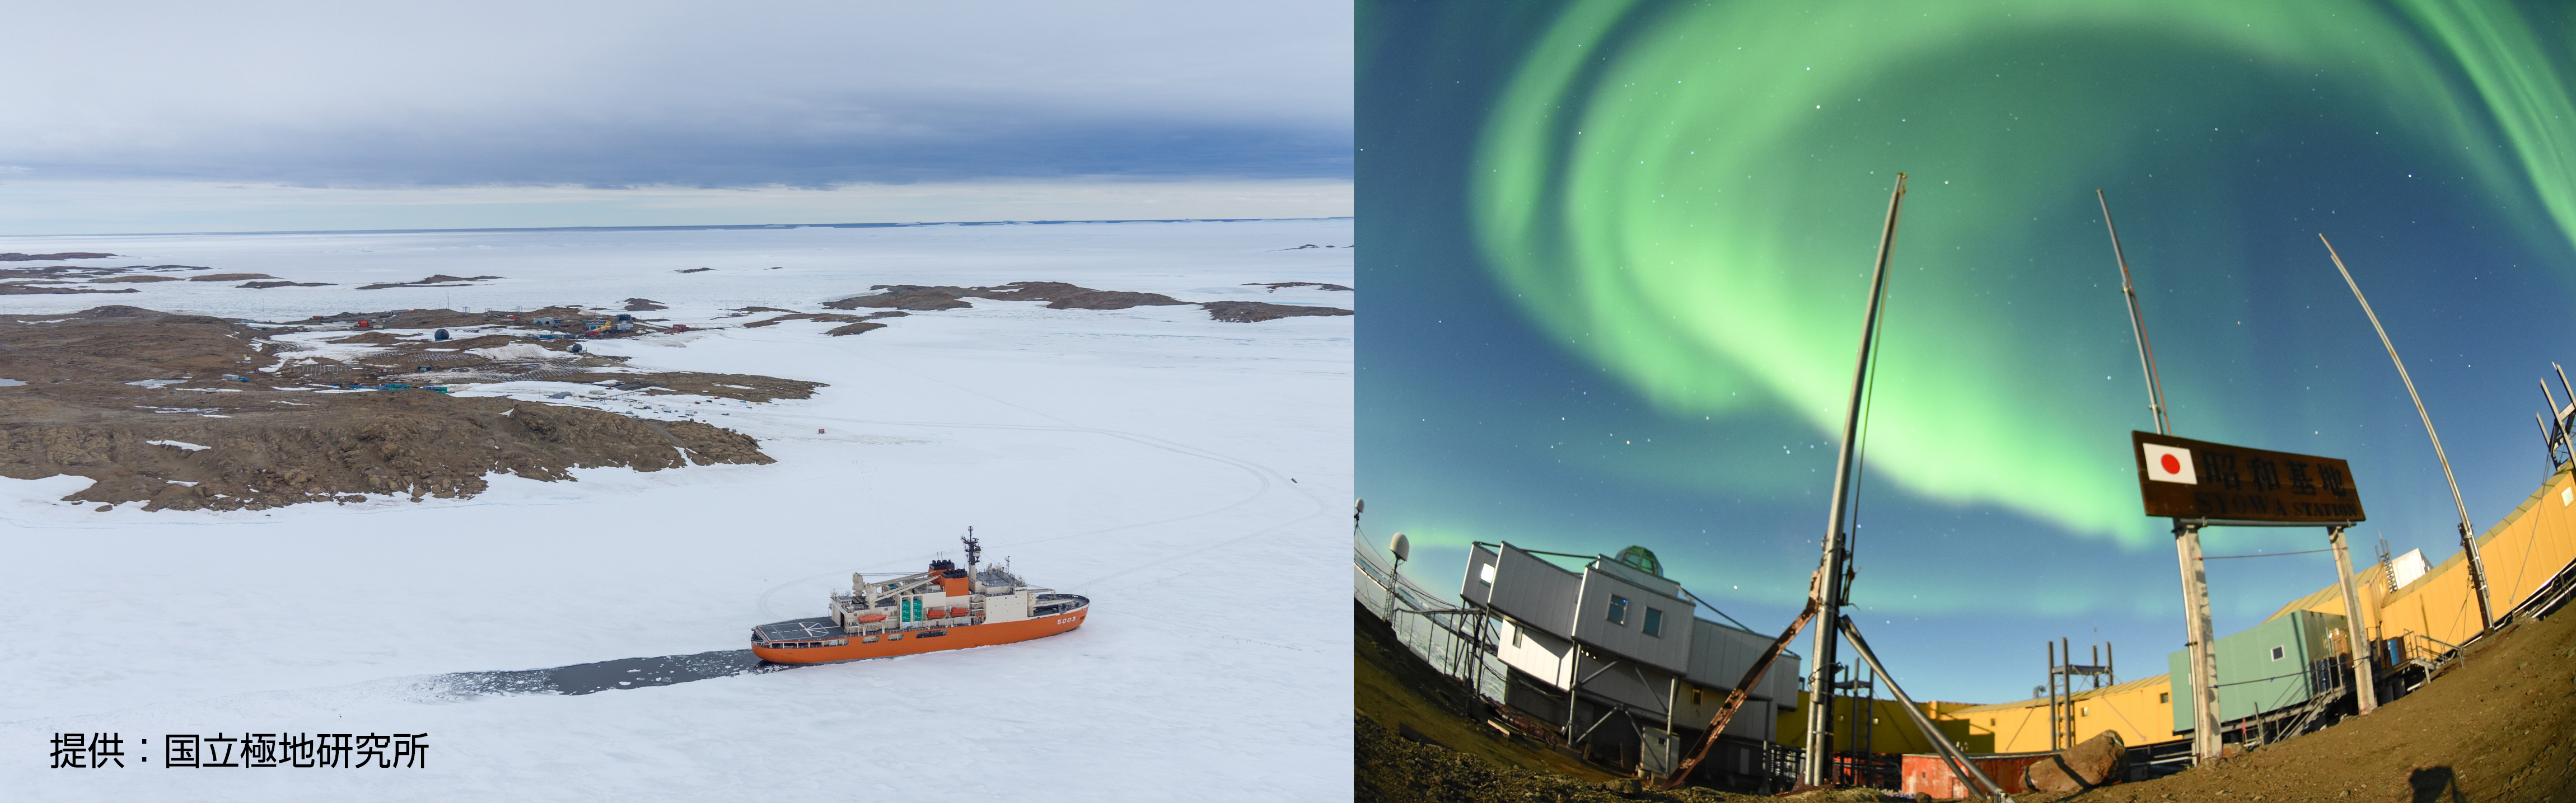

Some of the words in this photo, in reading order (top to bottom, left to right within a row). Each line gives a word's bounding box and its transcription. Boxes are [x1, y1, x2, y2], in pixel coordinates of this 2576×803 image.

[2201, 450, 2346, 497] 昭和基地
[2195, 492, 2287, 516] SYOWA
[2293, 502, 2358, 516] STATION
[1057, 616, 1076, 625] 5003
